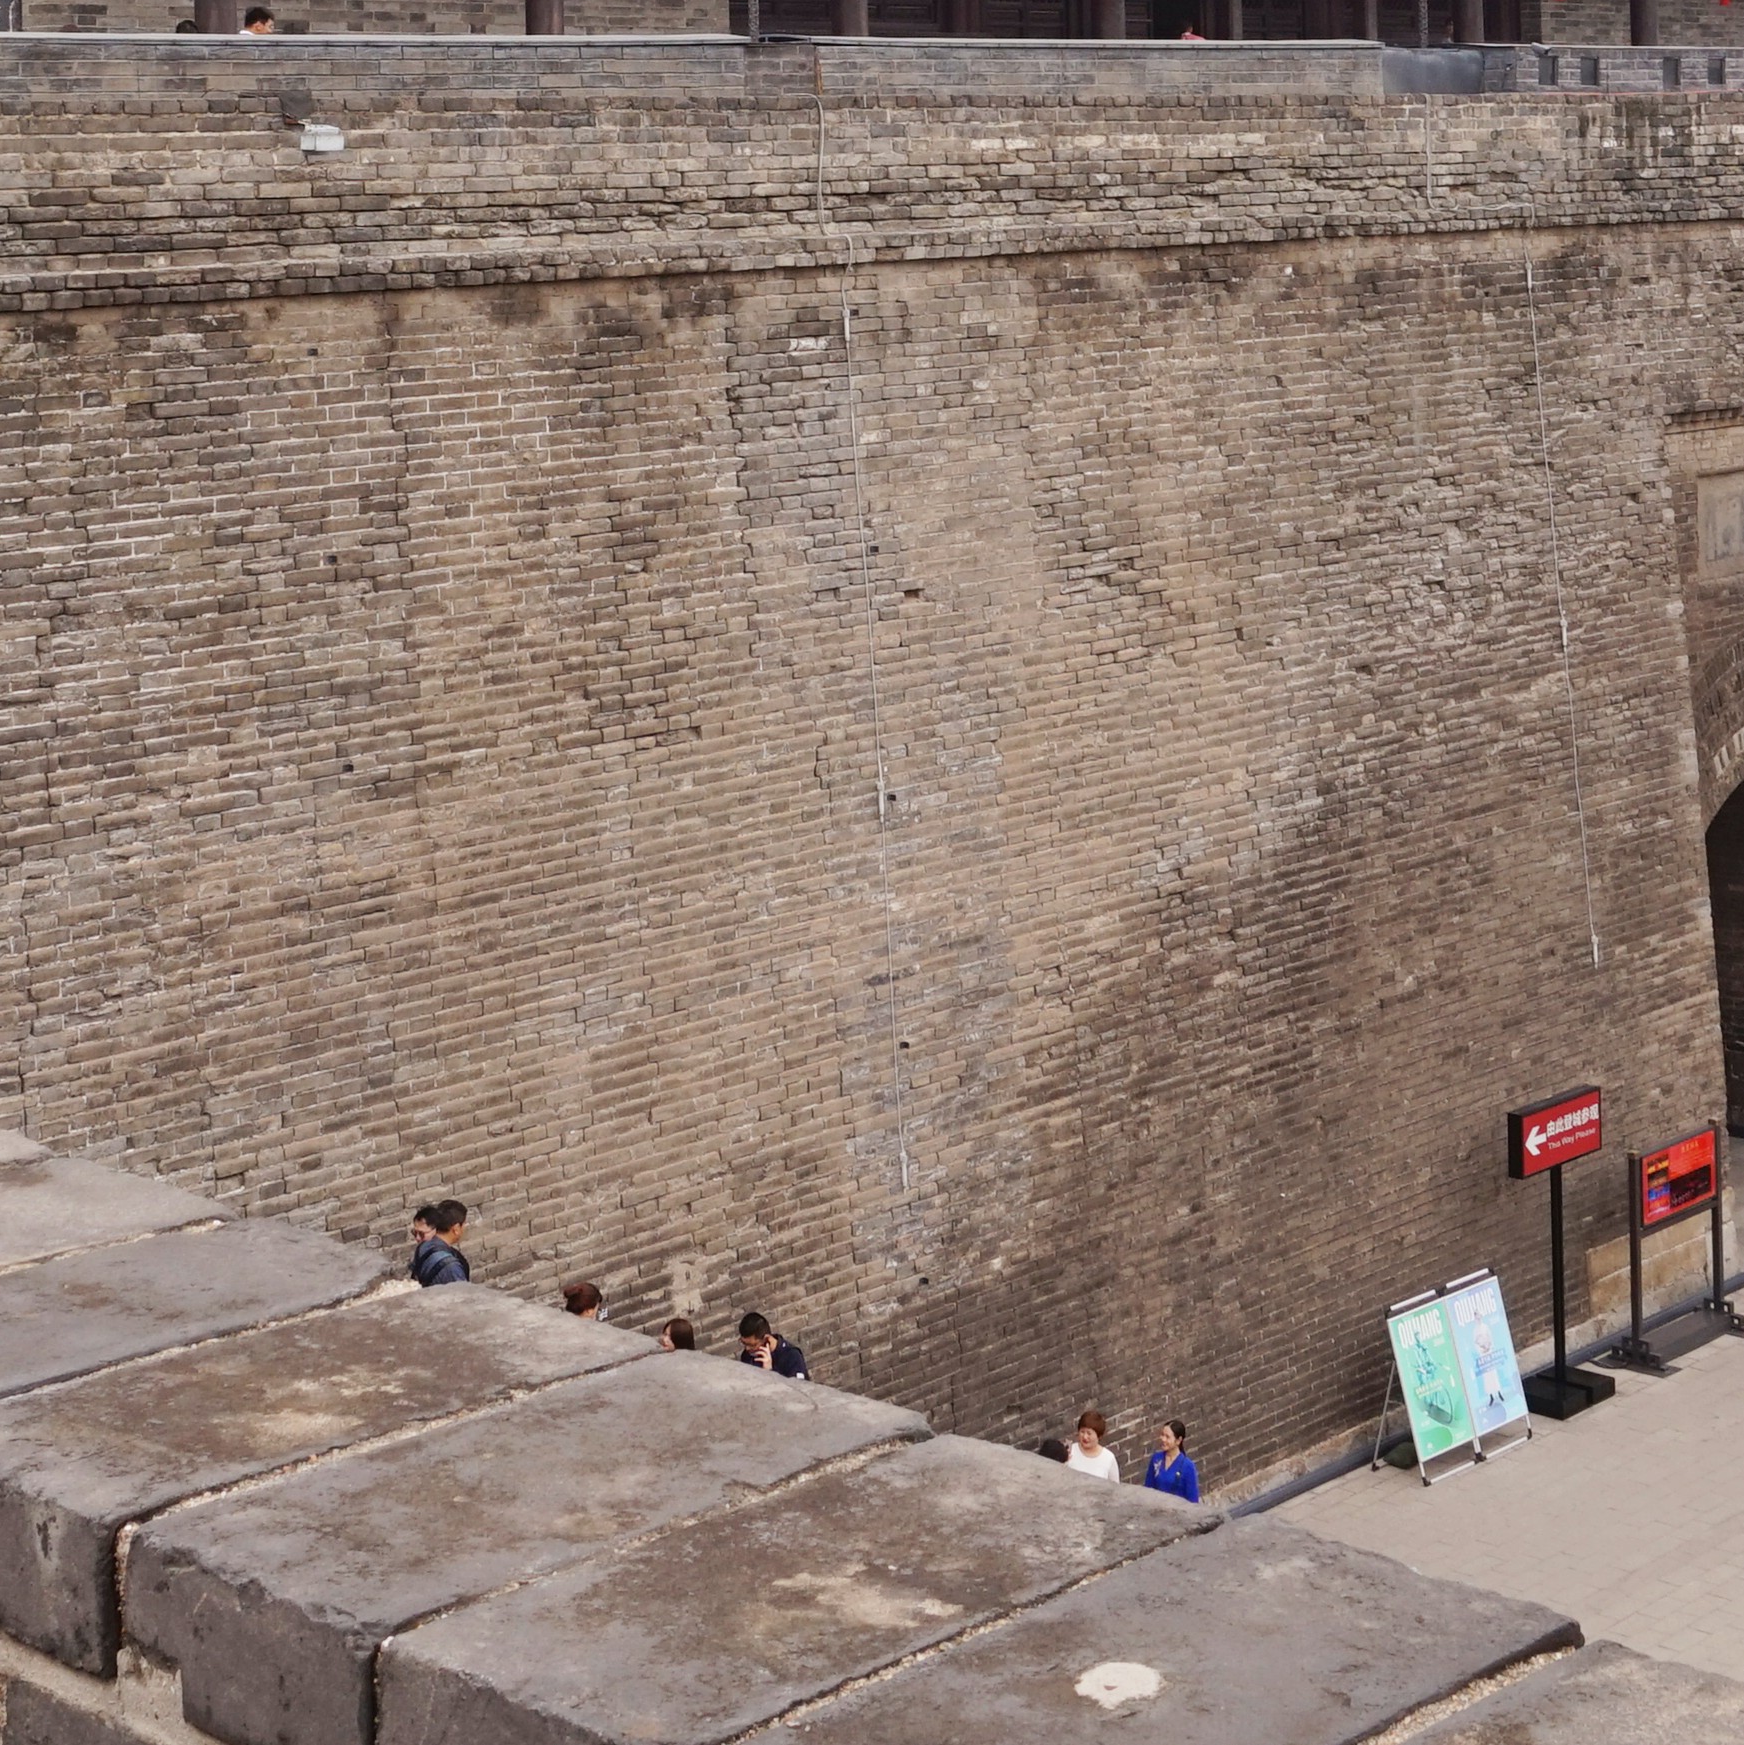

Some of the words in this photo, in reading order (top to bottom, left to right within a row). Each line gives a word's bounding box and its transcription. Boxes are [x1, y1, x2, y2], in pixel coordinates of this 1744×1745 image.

[1547, 1140, 1561, 1150] This
[1561, 1135, 1575, 1146] Way
[1575, 1127, 1597, 1140] Please
